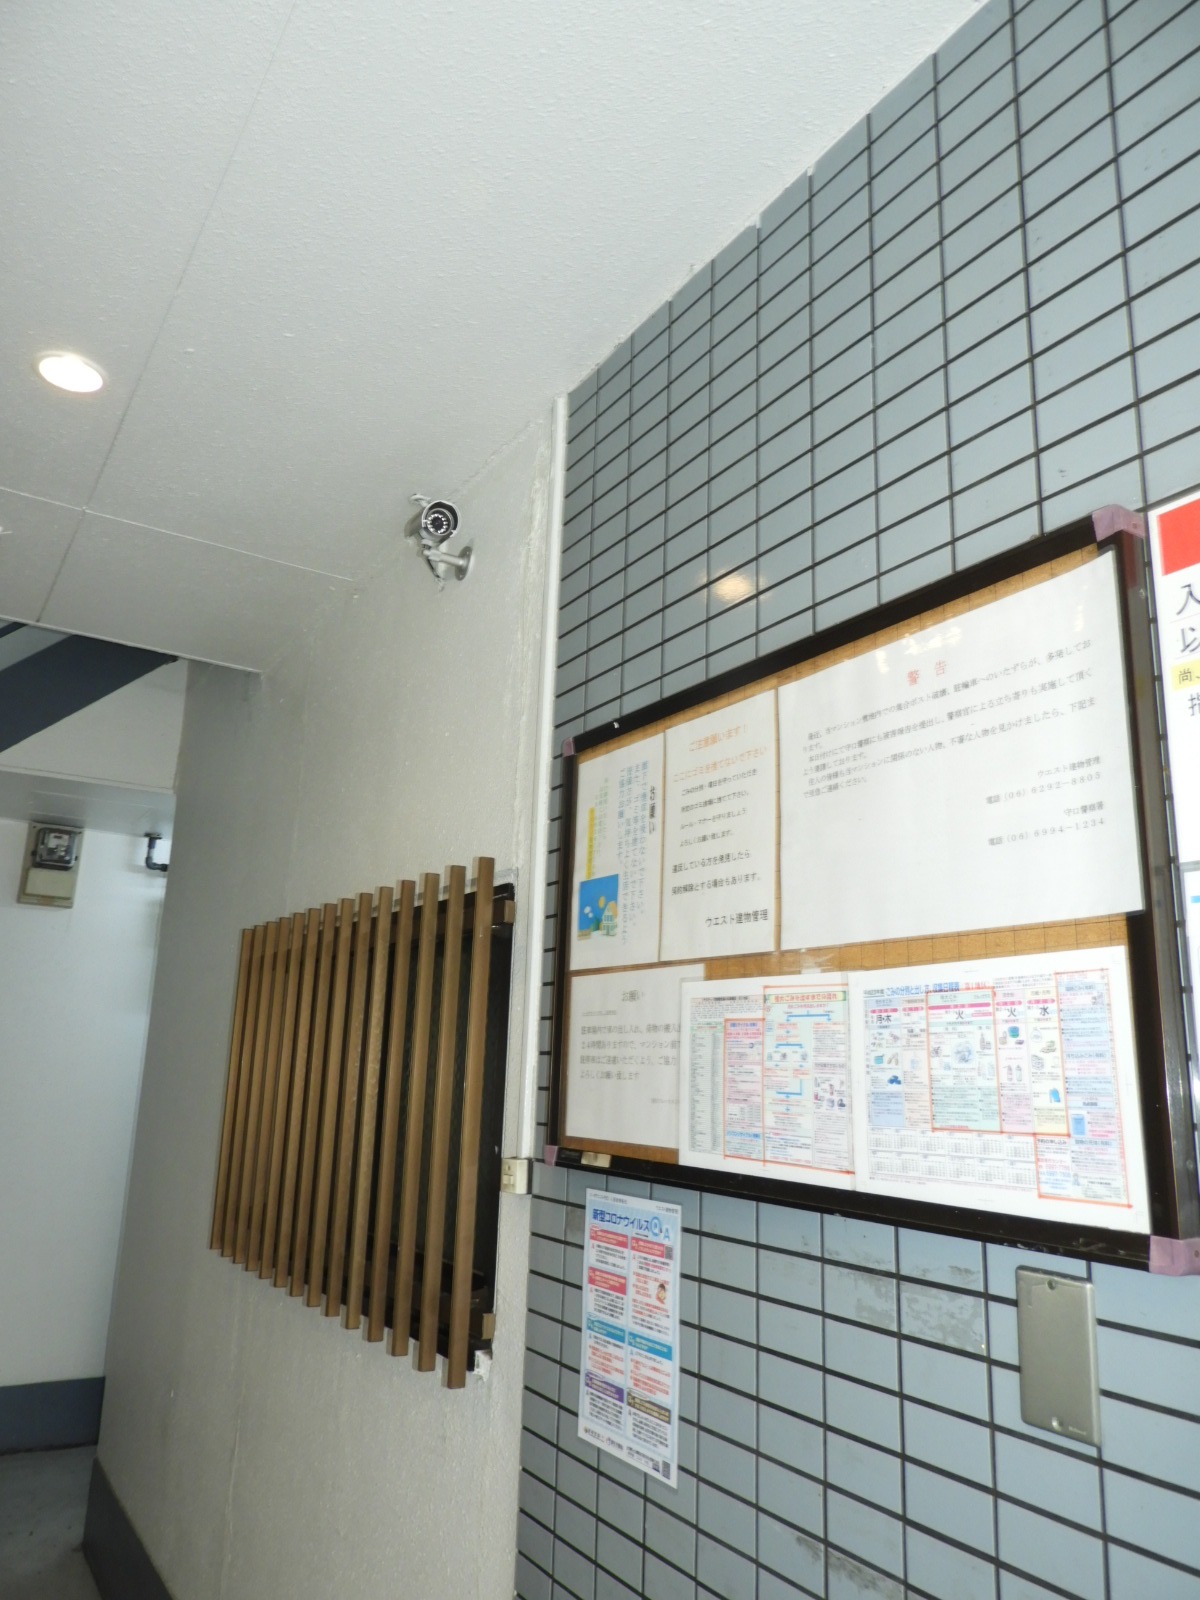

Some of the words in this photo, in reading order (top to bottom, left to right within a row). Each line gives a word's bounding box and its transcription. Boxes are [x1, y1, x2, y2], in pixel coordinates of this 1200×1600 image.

[1064, 802, 1104, 818] 守口警察署
[705, 910, 768, 926] ウエスト建物管理
[592, 1208, 649, 1233] 新型コロナウイルス
